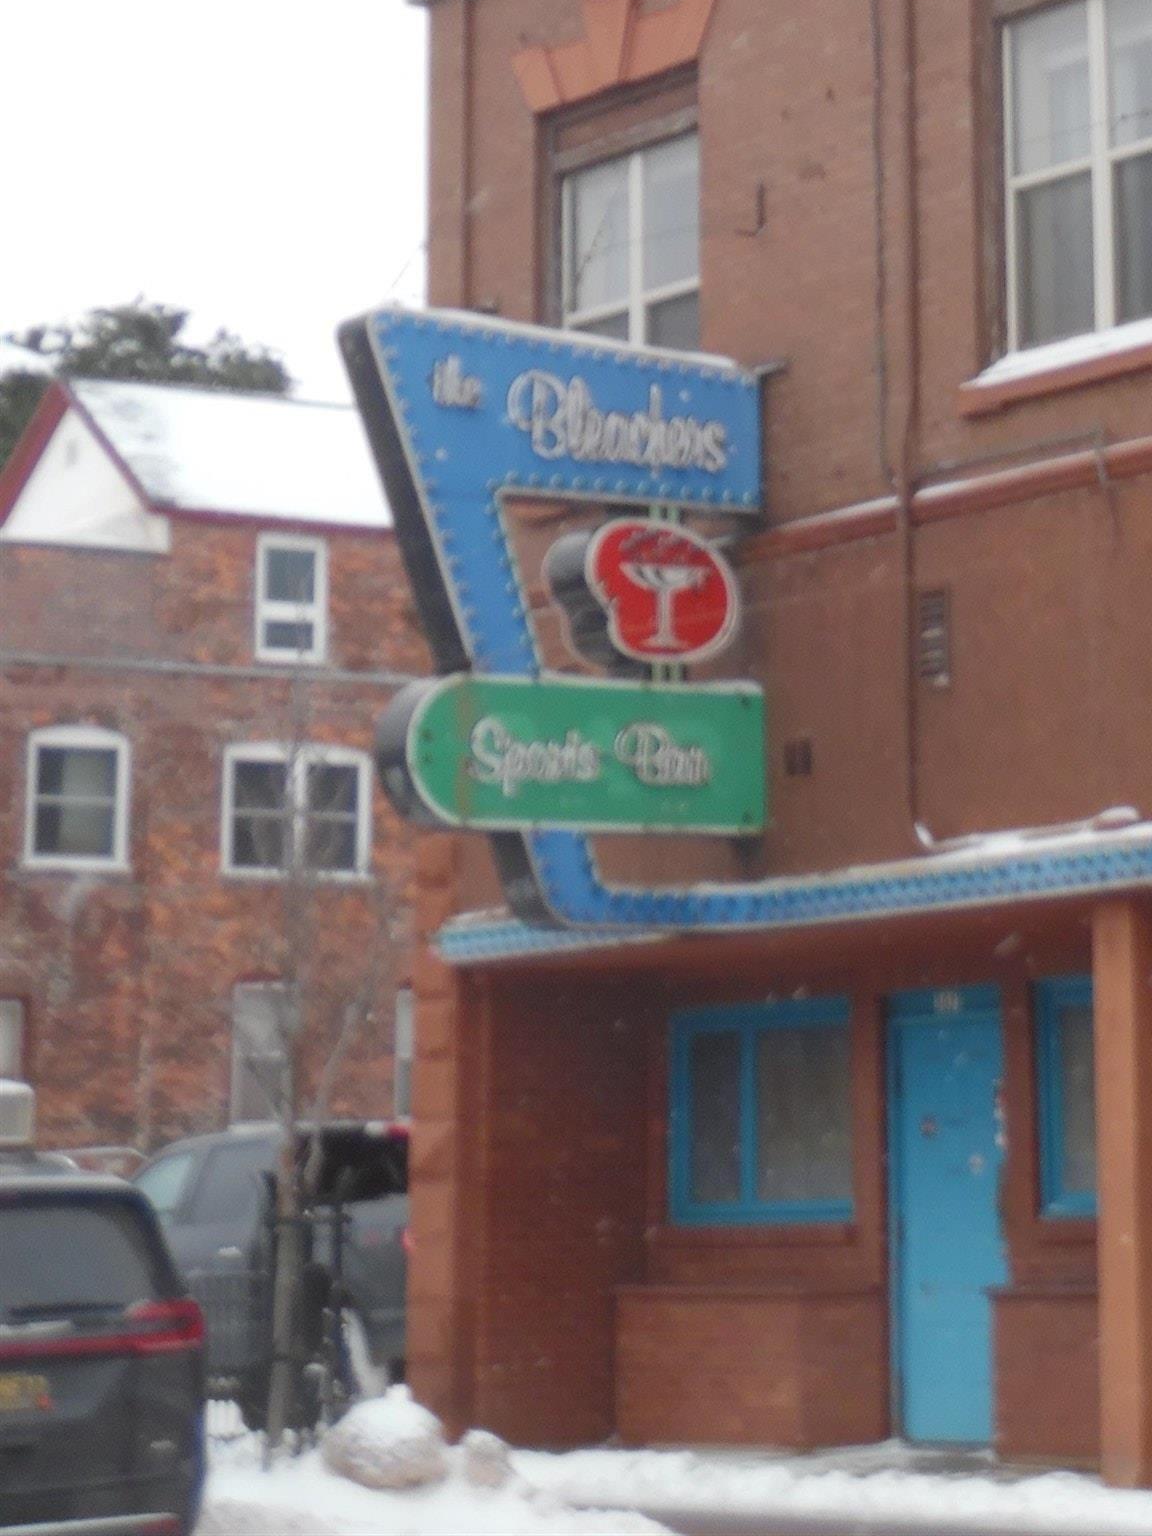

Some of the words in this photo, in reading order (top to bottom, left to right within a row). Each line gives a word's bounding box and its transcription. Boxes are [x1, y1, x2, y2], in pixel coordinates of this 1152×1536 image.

[433, 354, 482, 408] the
[507, 369, 728, 476] Bleachers
[468, 716, 600, 797] Sports
[613, 720, 712, 787] Bar
